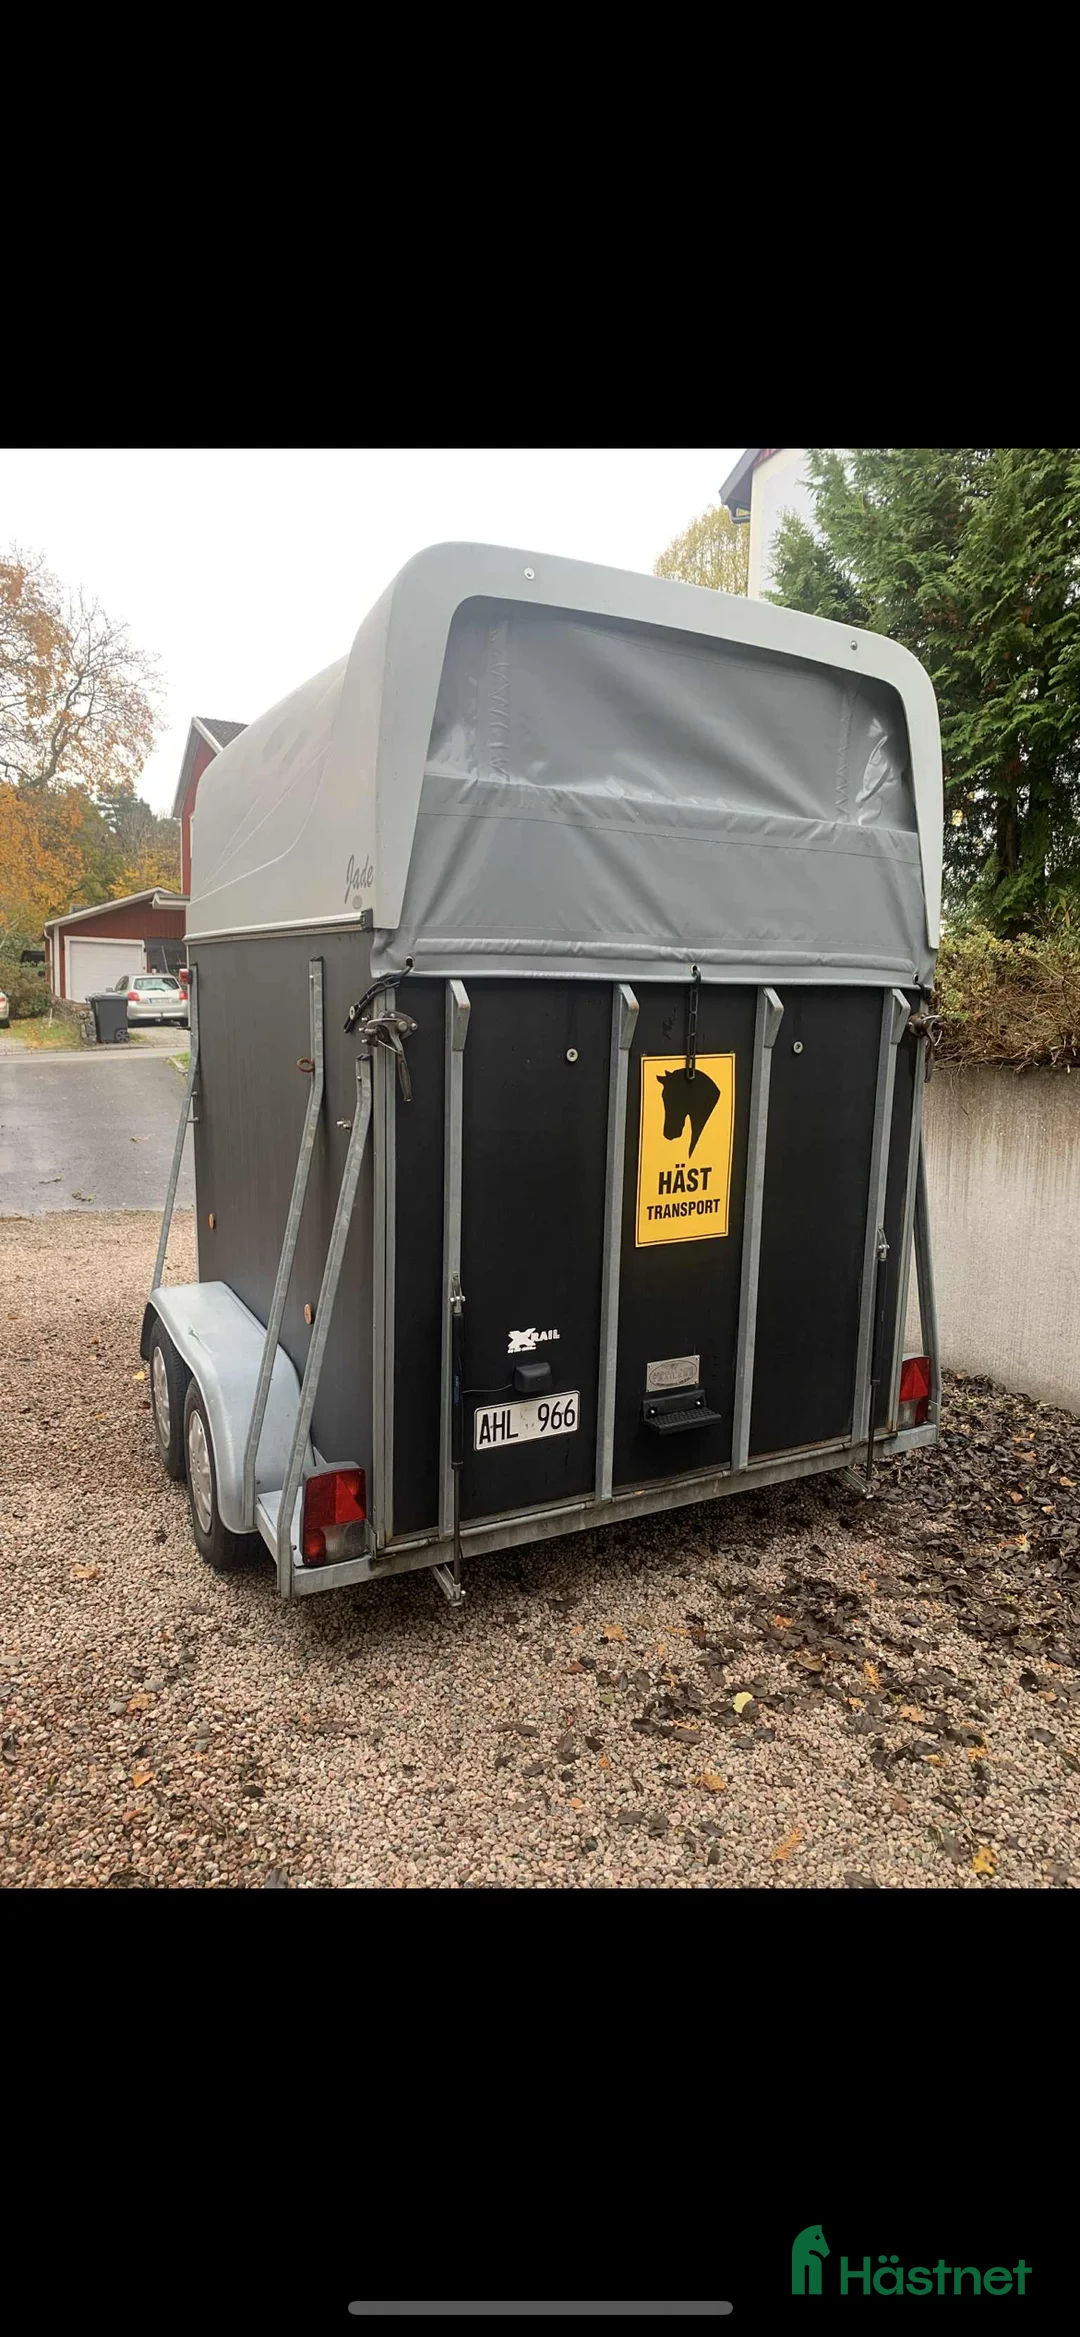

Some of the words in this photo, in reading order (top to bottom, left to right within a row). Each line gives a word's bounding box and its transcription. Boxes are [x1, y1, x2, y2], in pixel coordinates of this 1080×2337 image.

[344, 854, 374, 905] Jade
[658, 1163, 712, 1195] HÄST
[647, 1198, 721, 1221] TRANSPORT
[479, 1409, 519, 1445] AHL
[537, 1398, 576, 1432] 966
